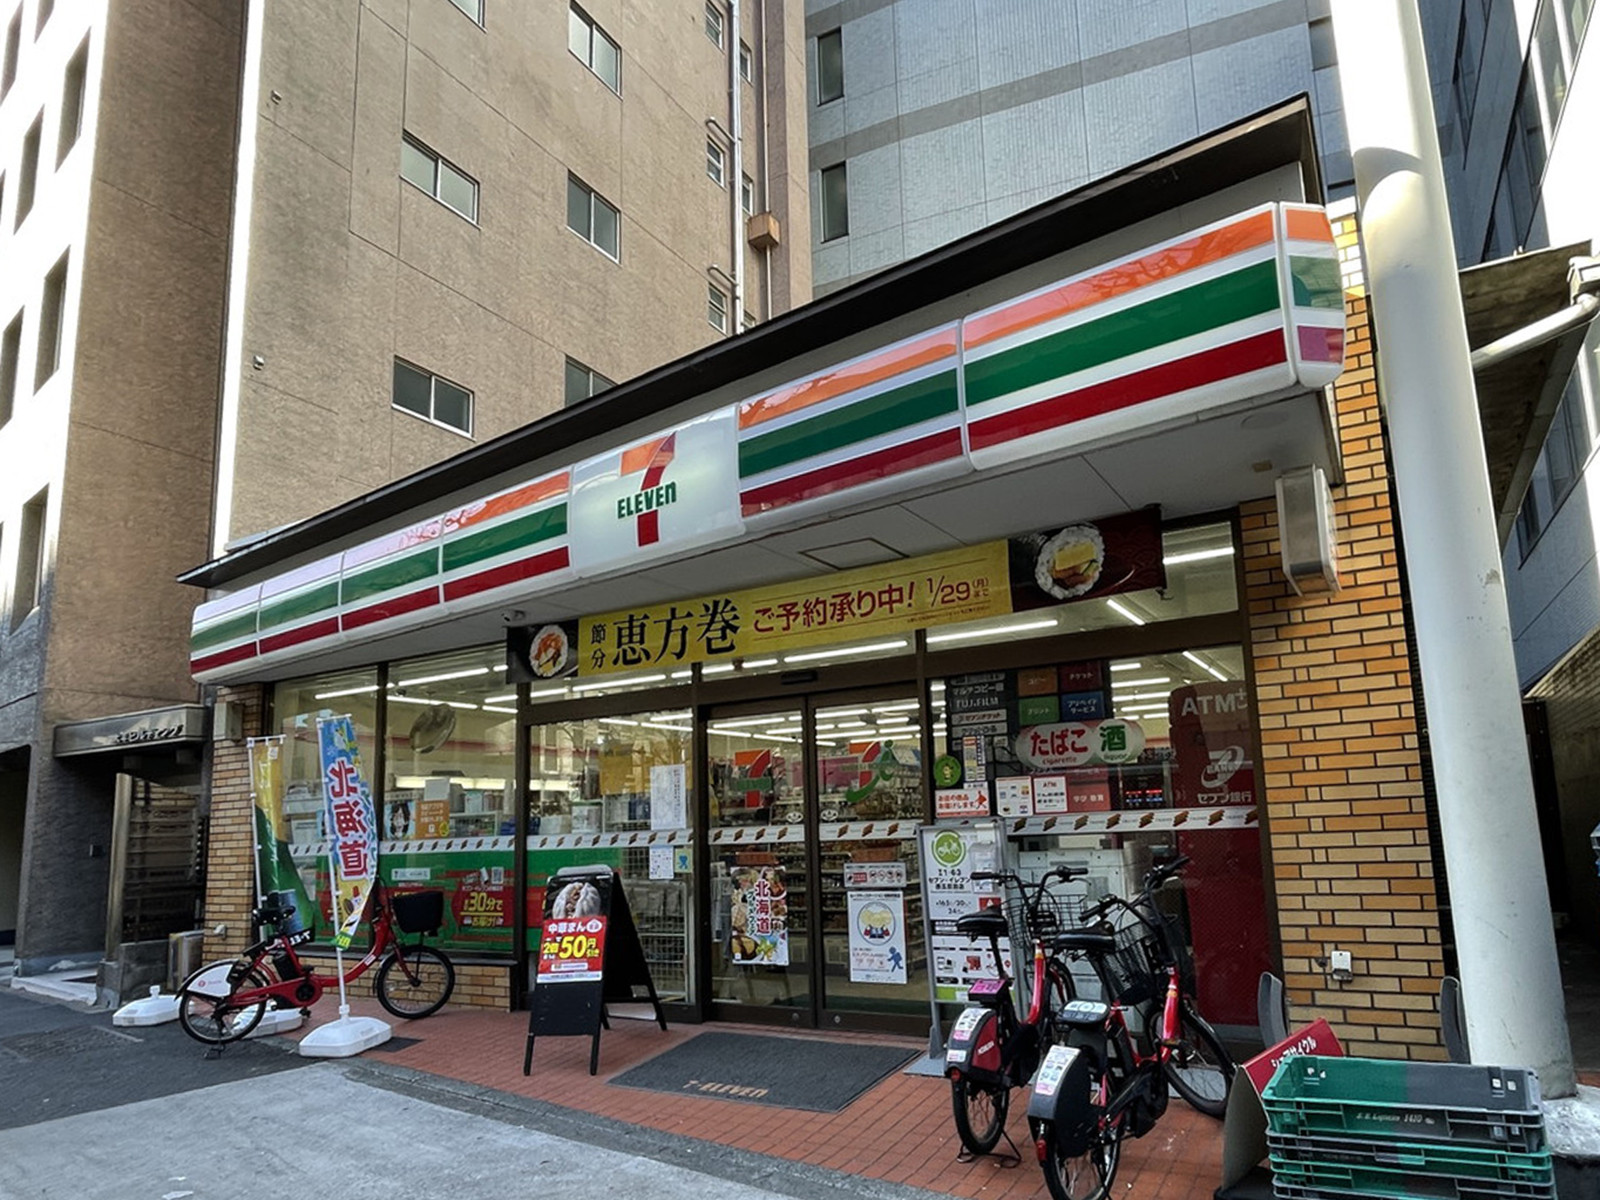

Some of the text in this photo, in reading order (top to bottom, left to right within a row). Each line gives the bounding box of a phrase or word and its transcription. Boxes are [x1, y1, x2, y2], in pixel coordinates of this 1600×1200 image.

[620, 431, 676, 546] 7
[753, 581, 915, 633] ご予約承り中!
[926, 576, 971, 607] 1/29
[591, 623, 607, 670] 節分
[612, 599, 740, 666] 恵方巻
[1181, 693, 1236, 717] ATM
[1030, 728, 1089, 757] たばこ
[1099, 724, 1127, 752] 酒
[755, 880, 770, 934] 北海道
